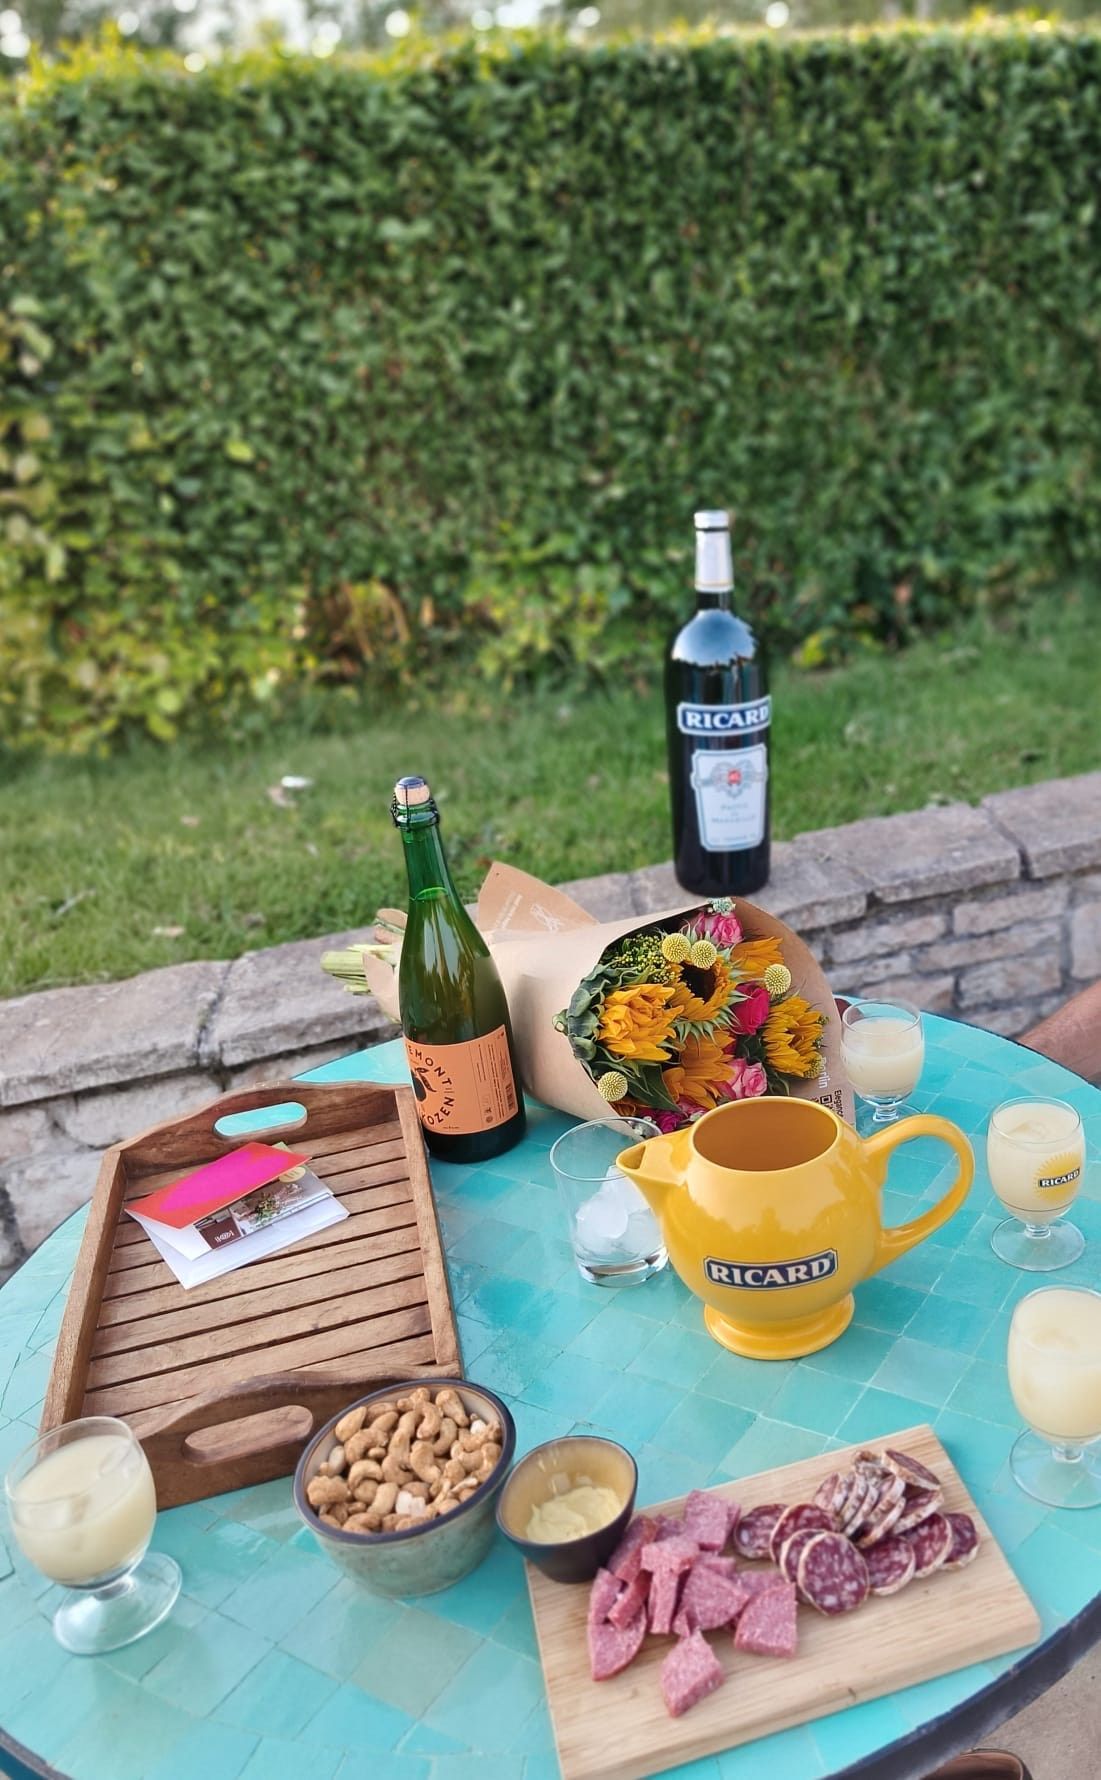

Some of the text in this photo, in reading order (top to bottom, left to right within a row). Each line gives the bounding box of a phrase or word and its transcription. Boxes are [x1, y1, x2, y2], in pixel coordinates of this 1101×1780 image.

[686, 705, 768, 729] RICARD
[1041, 1170, 1079, 1187] RICARD
[709, 1258, 831, 1286] RICARD
